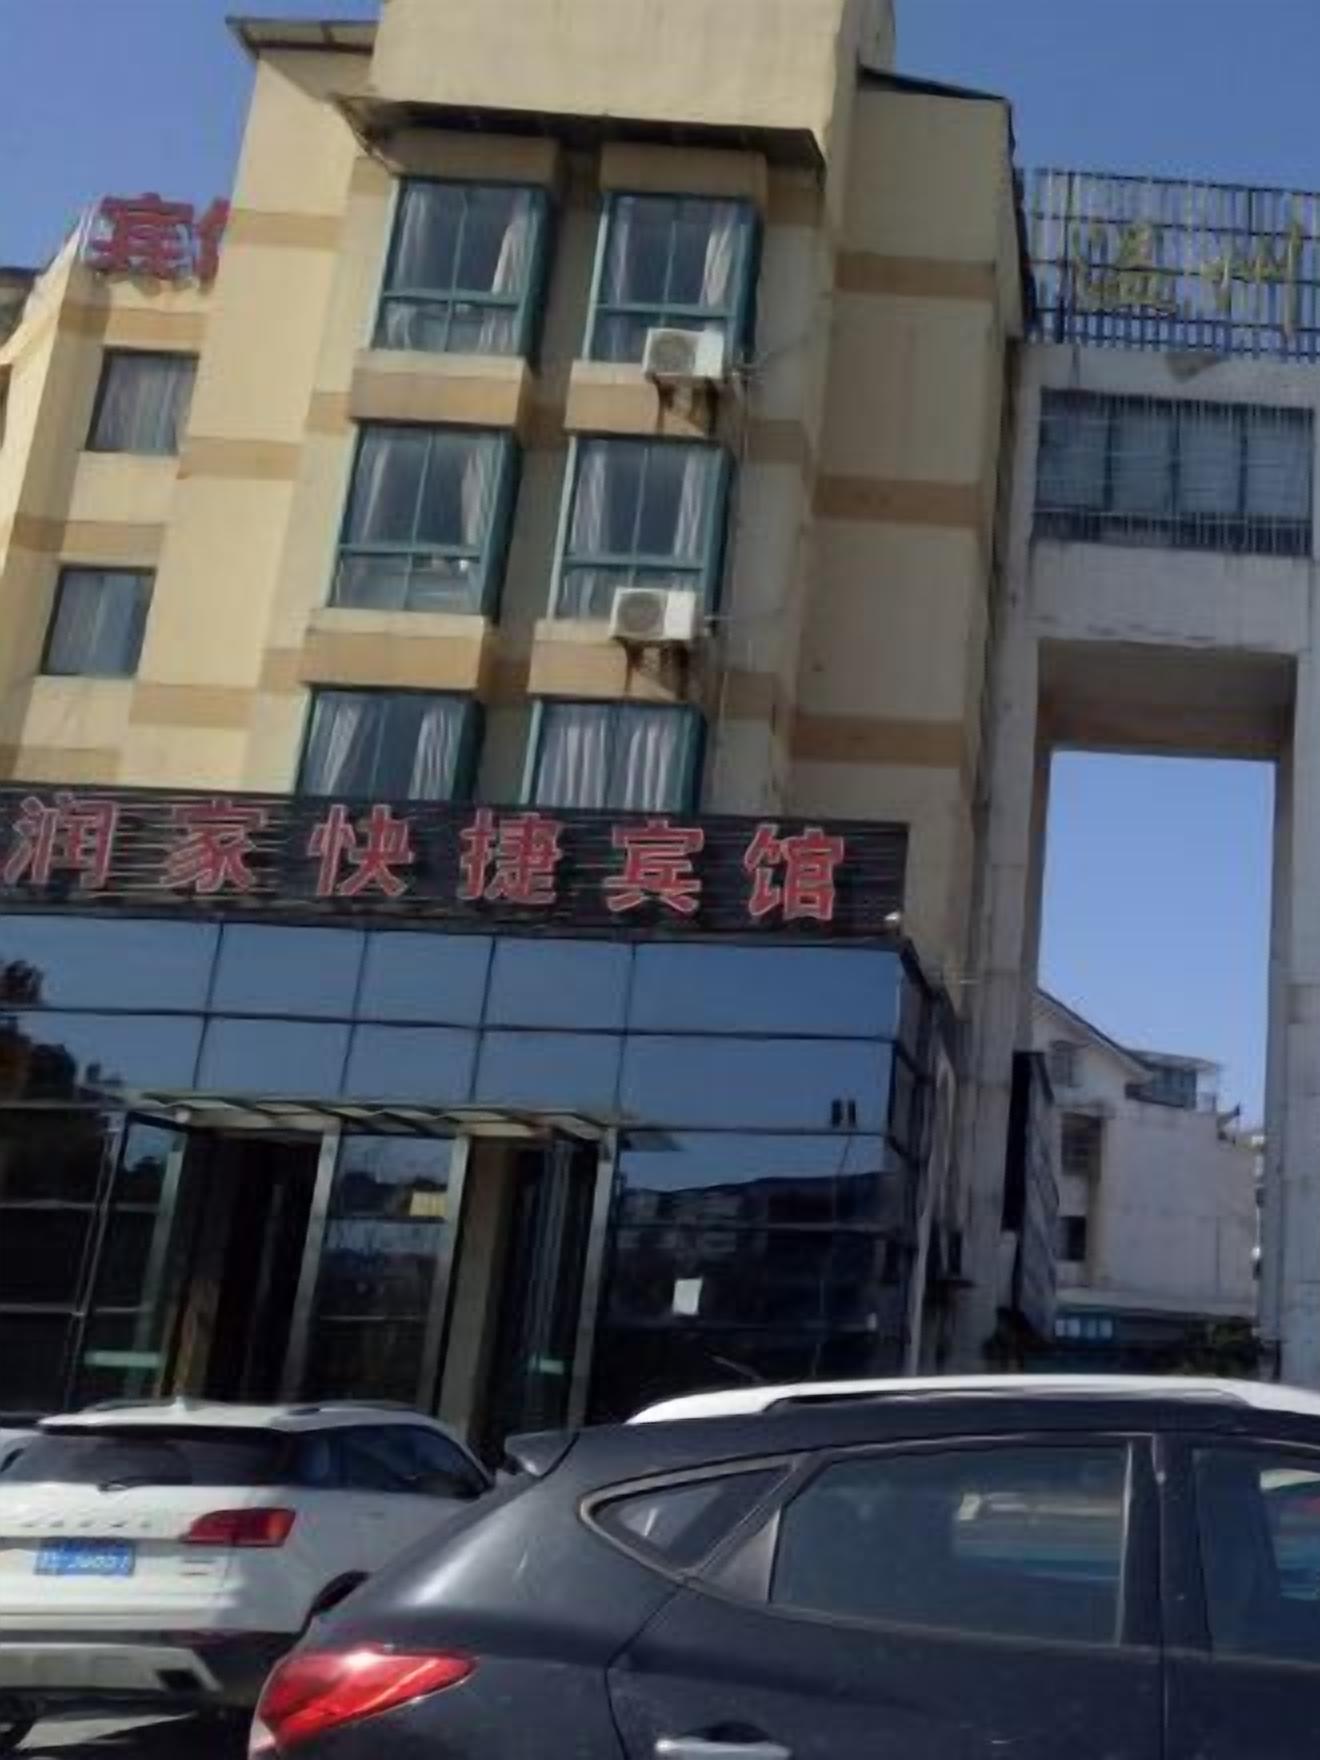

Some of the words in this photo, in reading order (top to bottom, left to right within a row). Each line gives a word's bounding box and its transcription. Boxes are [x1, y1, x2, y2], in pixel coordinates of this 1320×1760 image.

[2, 792, 847, 921] 润家快捷宾馆
